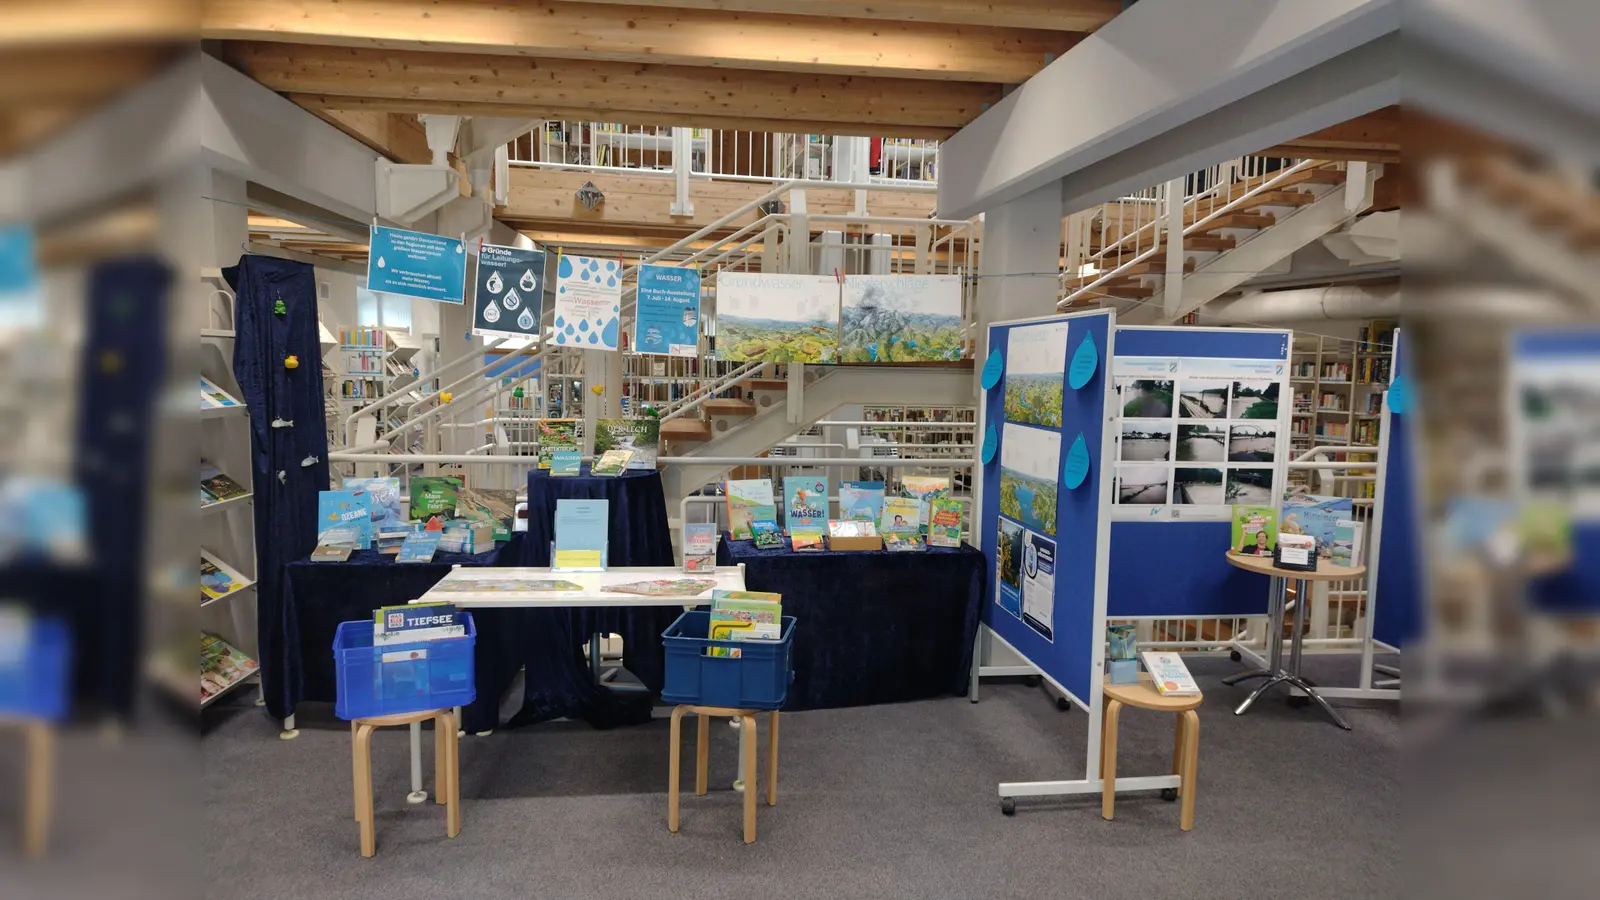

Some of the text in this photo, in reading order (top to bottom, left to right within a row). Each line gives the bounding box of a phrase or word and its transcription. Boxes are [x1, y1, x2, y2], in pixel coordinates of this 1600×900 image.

[487, 247, 511, 256] Gründe
[492, 254, 523, 263] Leitungs-
[720, 276, 803, 289] Grundwasser
[844, 275, 929, 290] Niederschläge
[653, 289, 696, 297] Buch-Ausstellung
[573, 296, 603, 306] Wasser
[341, 508, 367, 521] OZEANE
[790, 509, 824, 518] WASSER!
[407, 615, 452, 626] TIEFSEE
